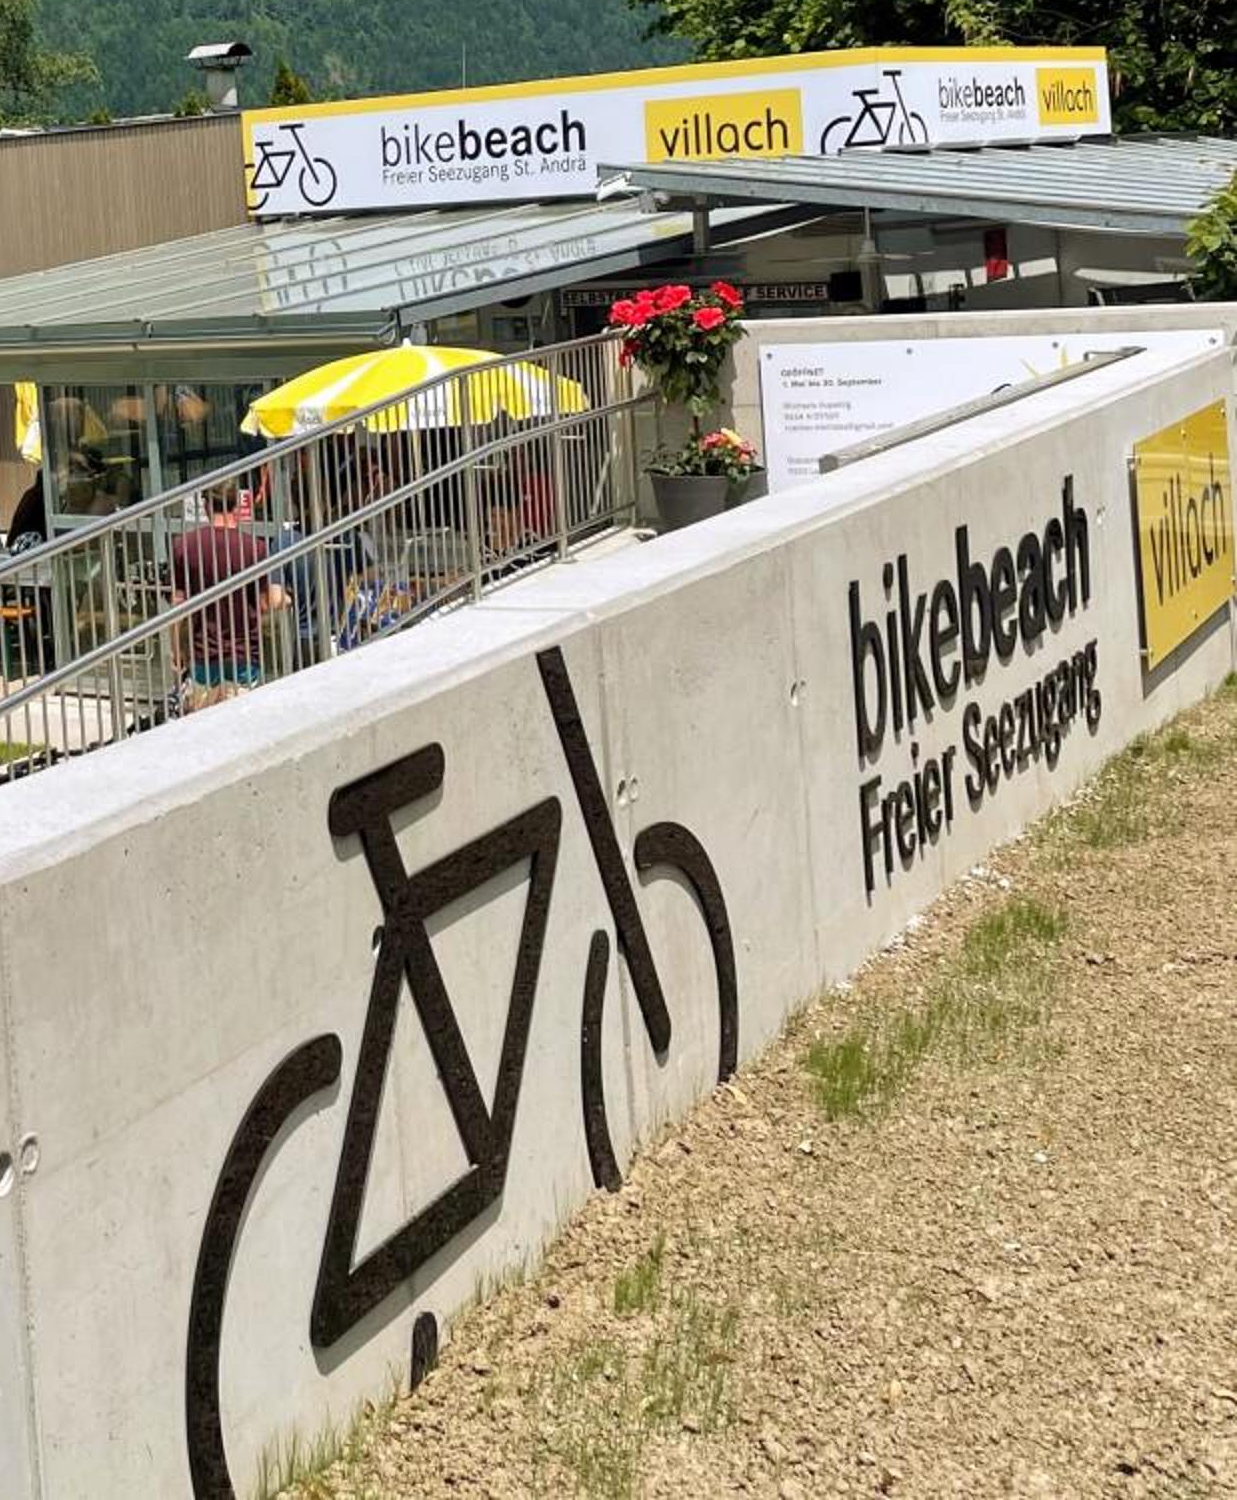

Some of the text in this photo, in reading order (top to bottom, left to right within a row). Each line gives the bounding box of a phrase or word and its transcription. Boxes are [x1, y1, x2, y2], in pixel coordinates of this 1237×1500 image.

[938, 77, 1026, 109] bikebeach
[1042, 80, 1094, 113] villach
[380, 109, 587, 167] bikebeach
[659, 107, 789, 157] villach
[382, 154, 587, 185] Freier Seezugang St. Andrä
[756, 285, 824, 299] SERVICE
[1150, 451, 1227, 606] villach
[848, 474, 1090, 762] bikebeach
[859, 638, 1102, 897] Freier Seezugang
